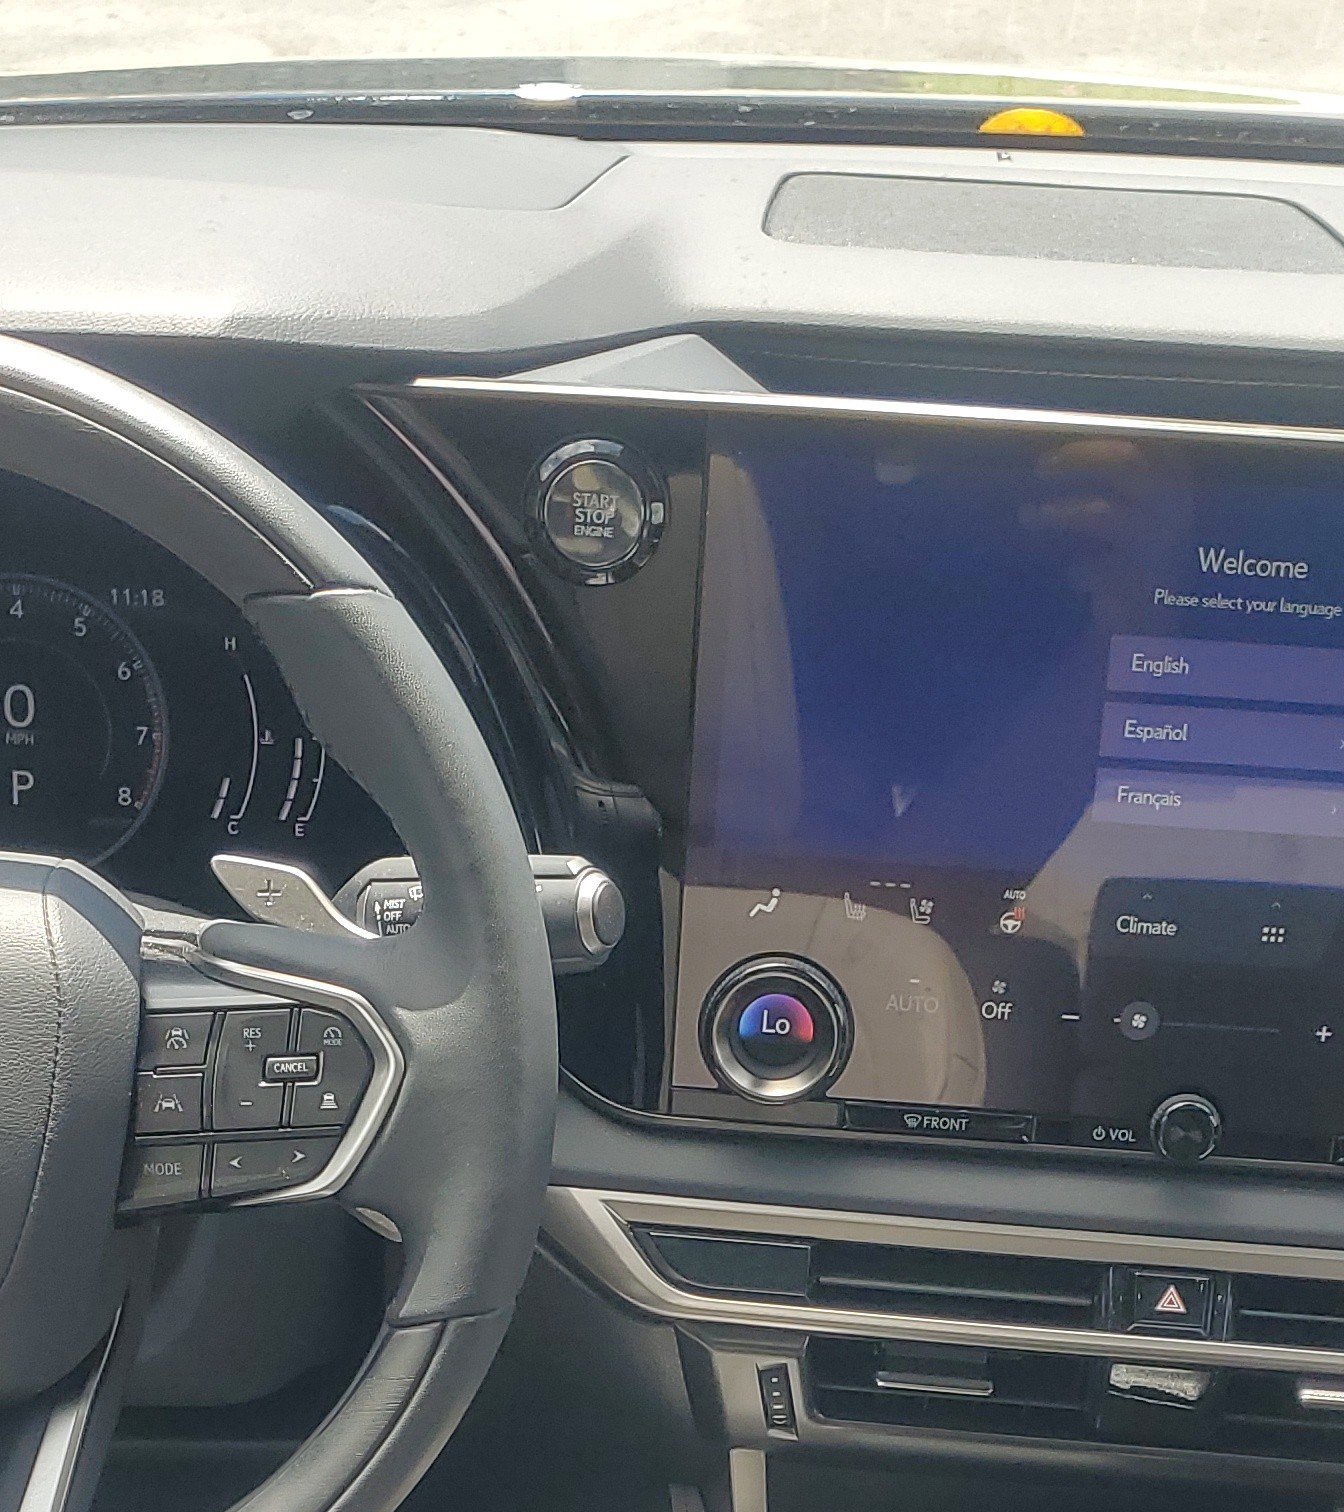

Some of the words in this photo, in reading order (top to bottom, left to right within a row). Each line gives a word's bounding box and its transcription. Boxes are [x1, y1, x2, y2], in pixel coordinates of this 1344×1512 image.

[573, 492, 619, 509] START
[575, 508, 615, 525] STOP
[574, 525, 615, 538] ENGINE
[1199, 547, 1309, 579] Welcome
[111, 589, 164, 607] 11:18
[1154, 588, 1199, 607] Please
[1202, 594, 1242, 611] select
[1246, 599, 1277, 613] your
[1280, 597, 1343, 619] language
[9, 599, 23, 619] 4
[74, 617, 87, 637] 5
[224, 636, 236, 651] H
[118, 661, 131, 681] 6
[1131, 653, 1189, 677] English
[4, 684, 35, 728] 0
[6, 732, 34, 746] MPH
[136, 726, 148, 746] 7
[1123, 719, 1188, 743] Español
[11, 769, 34, 806] P
[118, 787, 132, 806] 8
[1117, 785, 1181, 810] Français
[227, 821, 239, 835] C
[295, 823, 305, 837] E
[383, 898, 406, 909] MIST
[1003, 889, 1026, 900] AUTO
[383, 912, 402, 922] OFF
[1116, 915, 1178, 937] Climate
[885, 995, 938, 1013] AUTO
[981, 1001, 1014, 1021] Off
[761, 1009, 791, 1035] Lo
[243, 1027, 262, 1039] RES
[323, 1038, 344, 1046] MODE
[273, 1062, 309, 1074] CANCEL
[923, 1116, 970, 1131] FRONT
[1109, 1128, 1137, 1143] VOL
[142, 1162, 183, 1176] MODE
